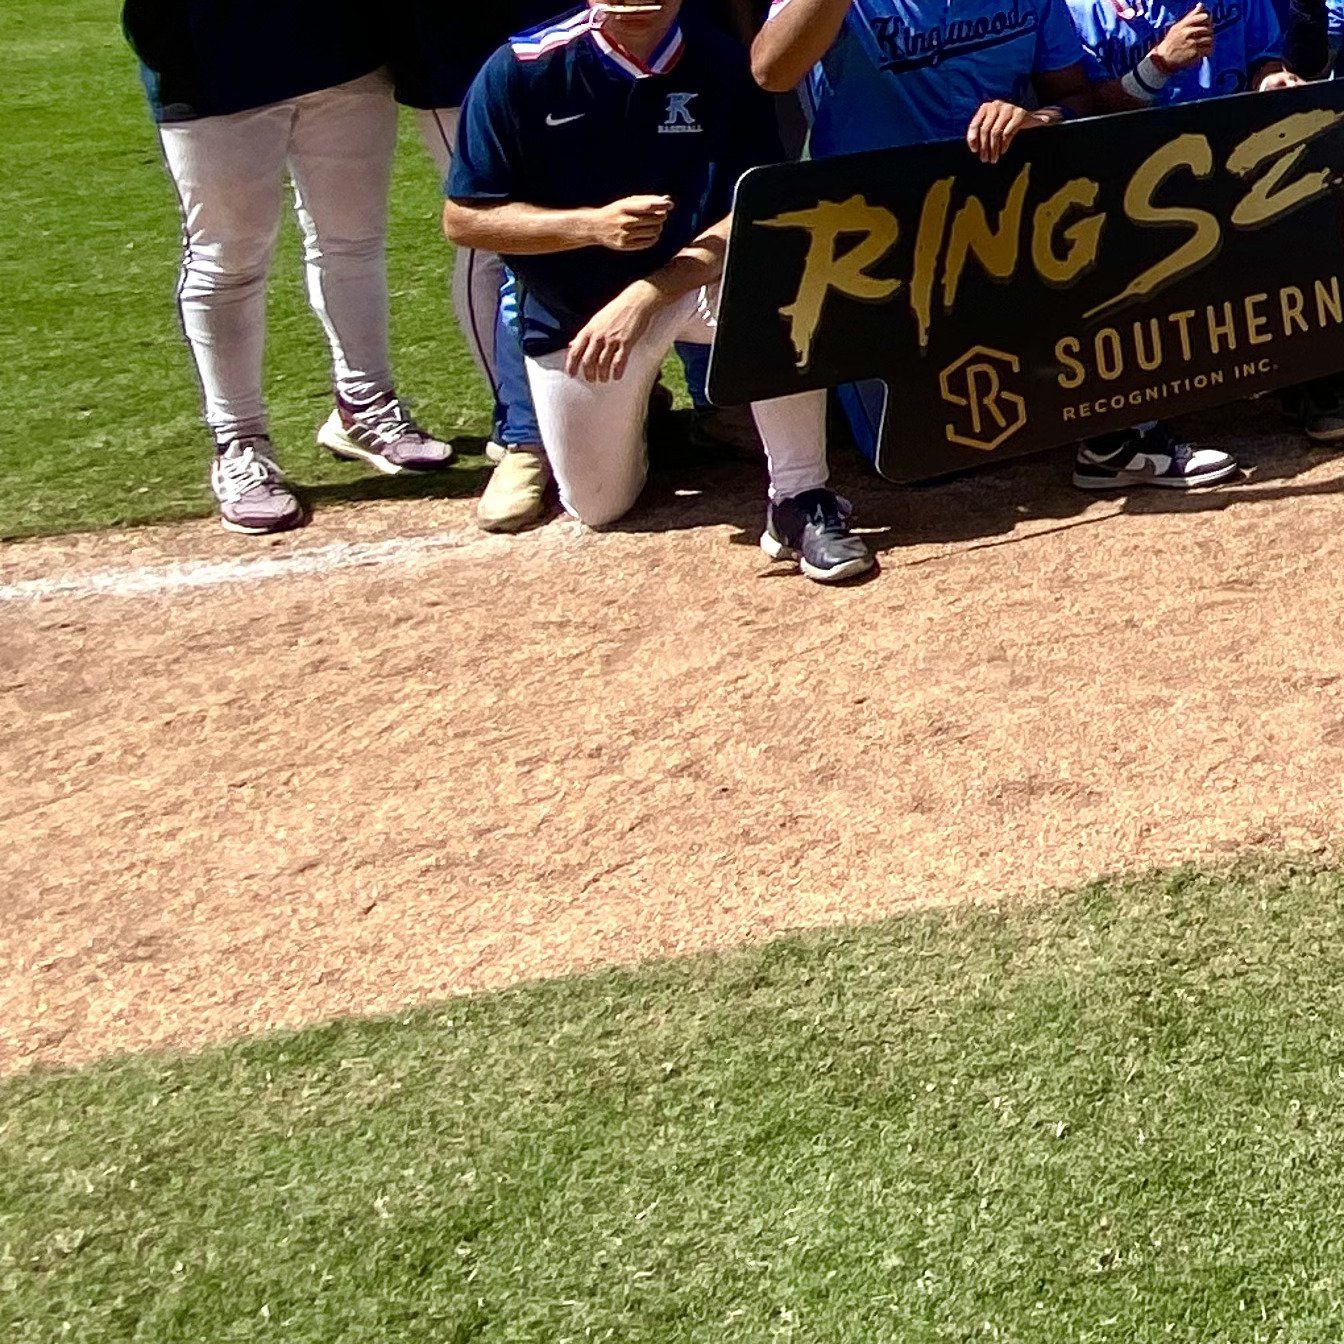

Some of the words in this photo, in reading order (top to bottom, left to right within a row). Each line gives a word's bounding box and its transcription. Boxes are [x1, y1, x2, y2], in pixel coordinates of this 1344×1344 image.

[664, 92, 699, 124] K
[1054, 275, 1343, 389] SOUTHERN
[1062, 367, 1225, 422] RECOGNITION
[1233, 358, 1280, 380] INC.
